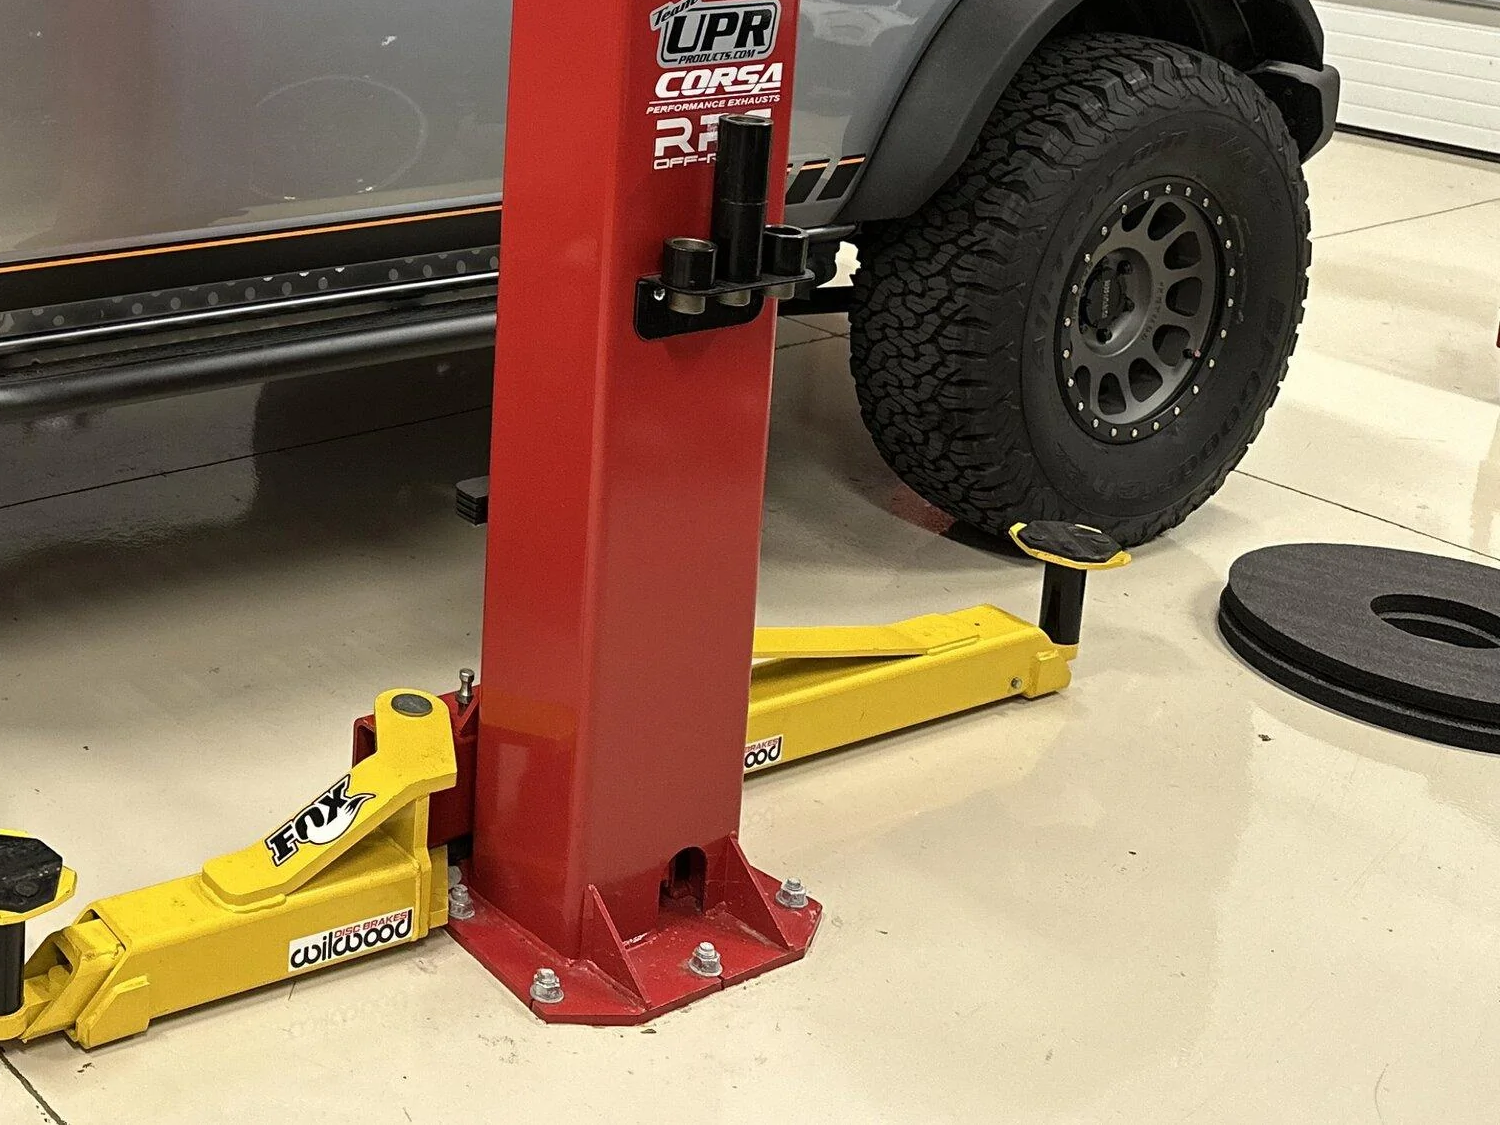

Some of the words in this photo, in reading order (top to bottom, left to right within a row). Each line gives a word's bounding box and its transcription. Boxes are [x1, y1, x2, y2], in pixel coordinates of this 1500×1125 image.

[666, 8, 773, 55] UPR
[678, 48, 756, 65] PRODUCTS.COM
[654, 62, 783, 99] CORSA
[646, 99, 726, 114] PERFORMANCE
[727, 94, 781, 107] EXHAUSTS
[268, 779, 350, 863] FOX
[290, 909, 413, 969] wilwood
[334, 923, 361, 939] DISC
[363, 910, 408, 930] BRAKES
